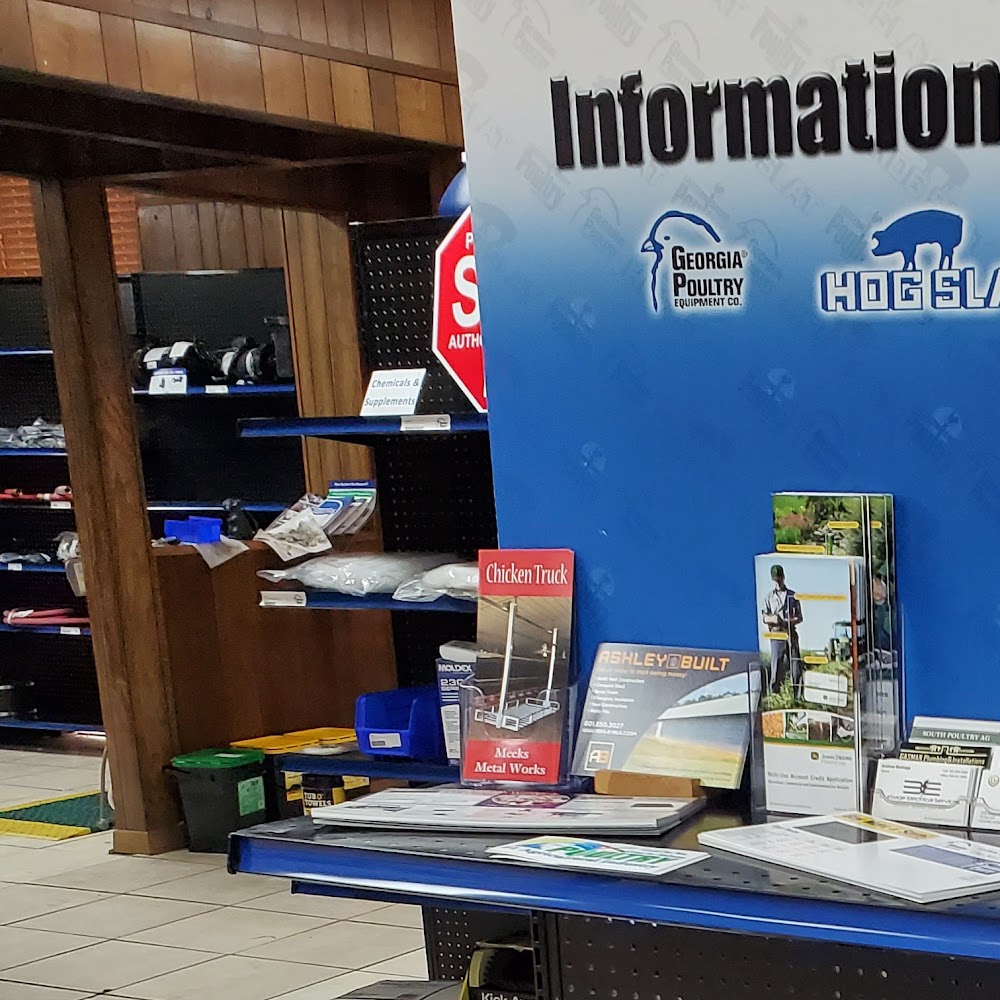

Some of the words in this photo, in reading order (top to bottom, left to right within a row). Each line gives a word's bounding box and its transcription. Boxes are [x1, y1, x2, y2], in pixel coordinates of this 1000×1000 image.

[673, 272, 744, 297] POULTRY
[821, 270, 923, 312] HOG
[674, 297, 725, 309] EQUIPMENT
[728, 297, 742, 306] CO.
[371, 378, 410, 389] Chemicals
[412, 378, 420, 388] &
[364, 397, 416, 408] Supplements
[486, 562, 532, 584] Chicken
[534, 563, 568, 584] Truck
[599, 651, 668, 666] ASHLEY
[680, 654, 731, 671] BUILT
[438, 663, 473, 672] MOLDEX
[947, 732, 979, 740] POULTRY
[494, 748, 530, 759] Meeks
[474, 761, 506, 773] Metal
[509, 762, 546, 775] Works
